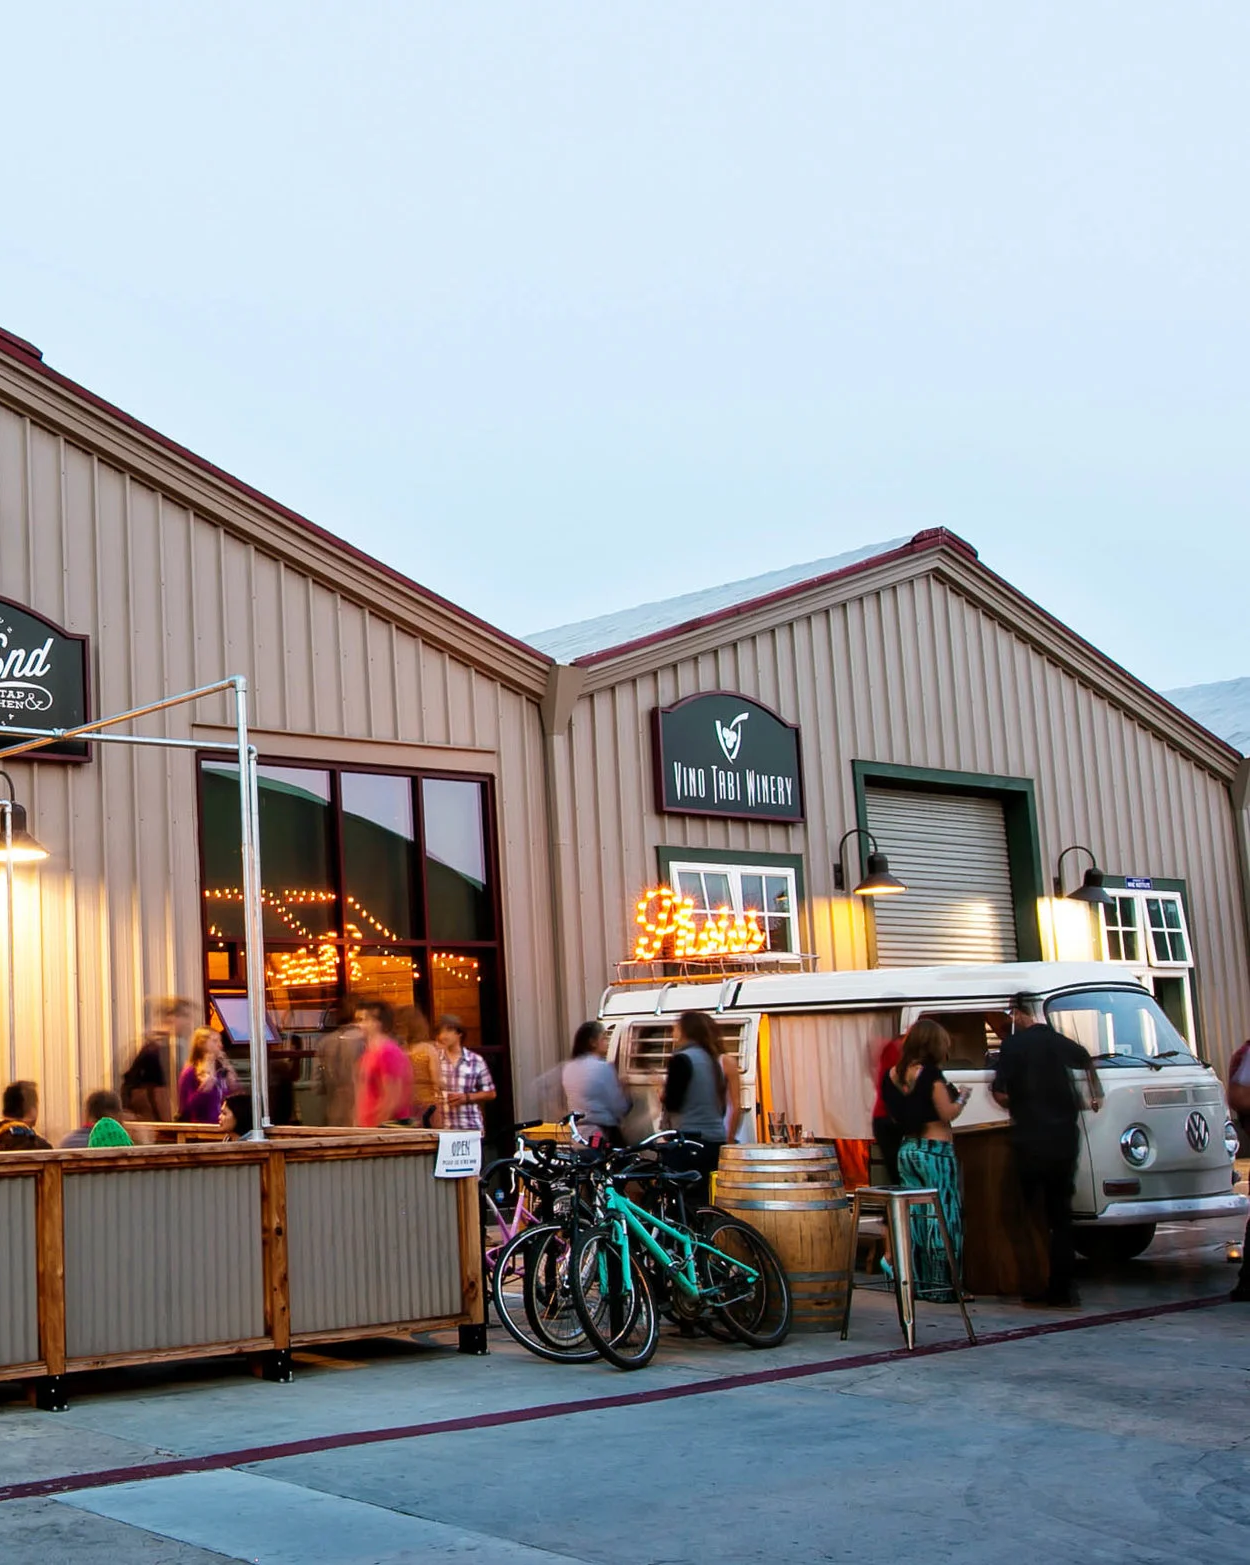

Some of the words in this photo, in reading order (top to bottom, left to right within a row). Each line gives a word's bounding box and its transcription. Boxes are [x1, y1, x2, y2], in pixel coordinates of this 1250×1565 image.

[673, 761, 706, 800] VINO
[711, 765, 741, 804] TABI
[746, 769, 792, 807] WINERY
